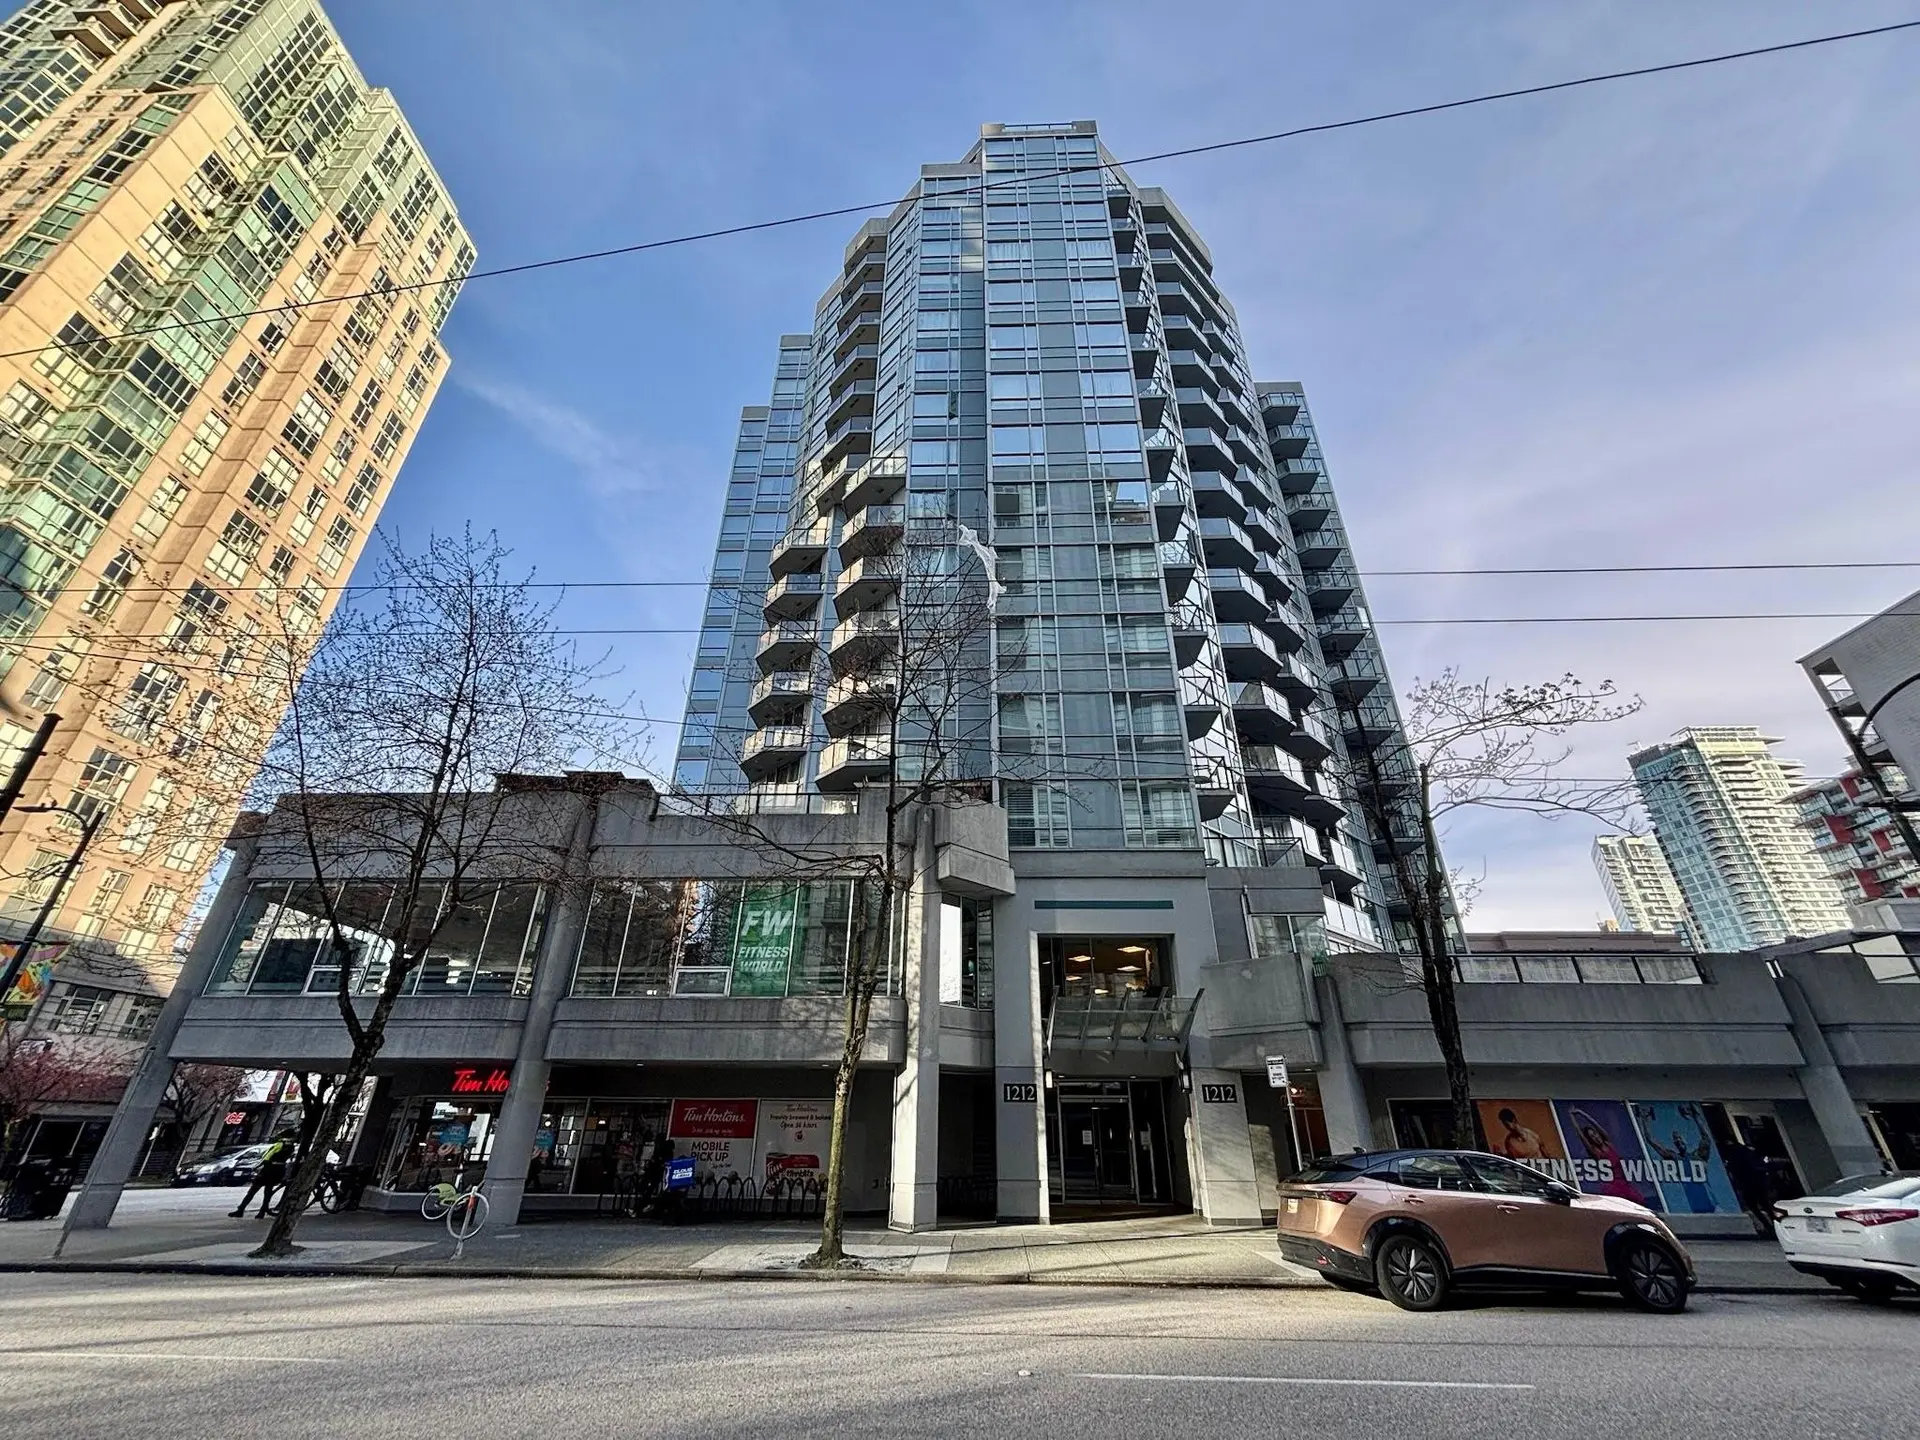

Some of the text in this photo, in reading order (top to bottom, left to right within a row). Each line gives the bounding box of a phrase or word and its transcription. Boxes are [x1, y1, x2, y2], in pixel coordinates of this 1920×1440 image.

[741, 910, 793, 936] FW
[738, 946, 789, 958] FITNESS
[739, 960, 784, 972] WORLD
[452, 1070, 482, 1092] Tim
[1006, 1085, 1035, 1101] 1212
[1204, 1086, 1235, 1101] 1212
[683, 1107, 746, 1122] Tim Hortons
[691, 1142, 730, 1151] MOBILE
[691, 1152, 729, 1161] PICK UP
[1620, 1159, 1707, 1183] WORLD
